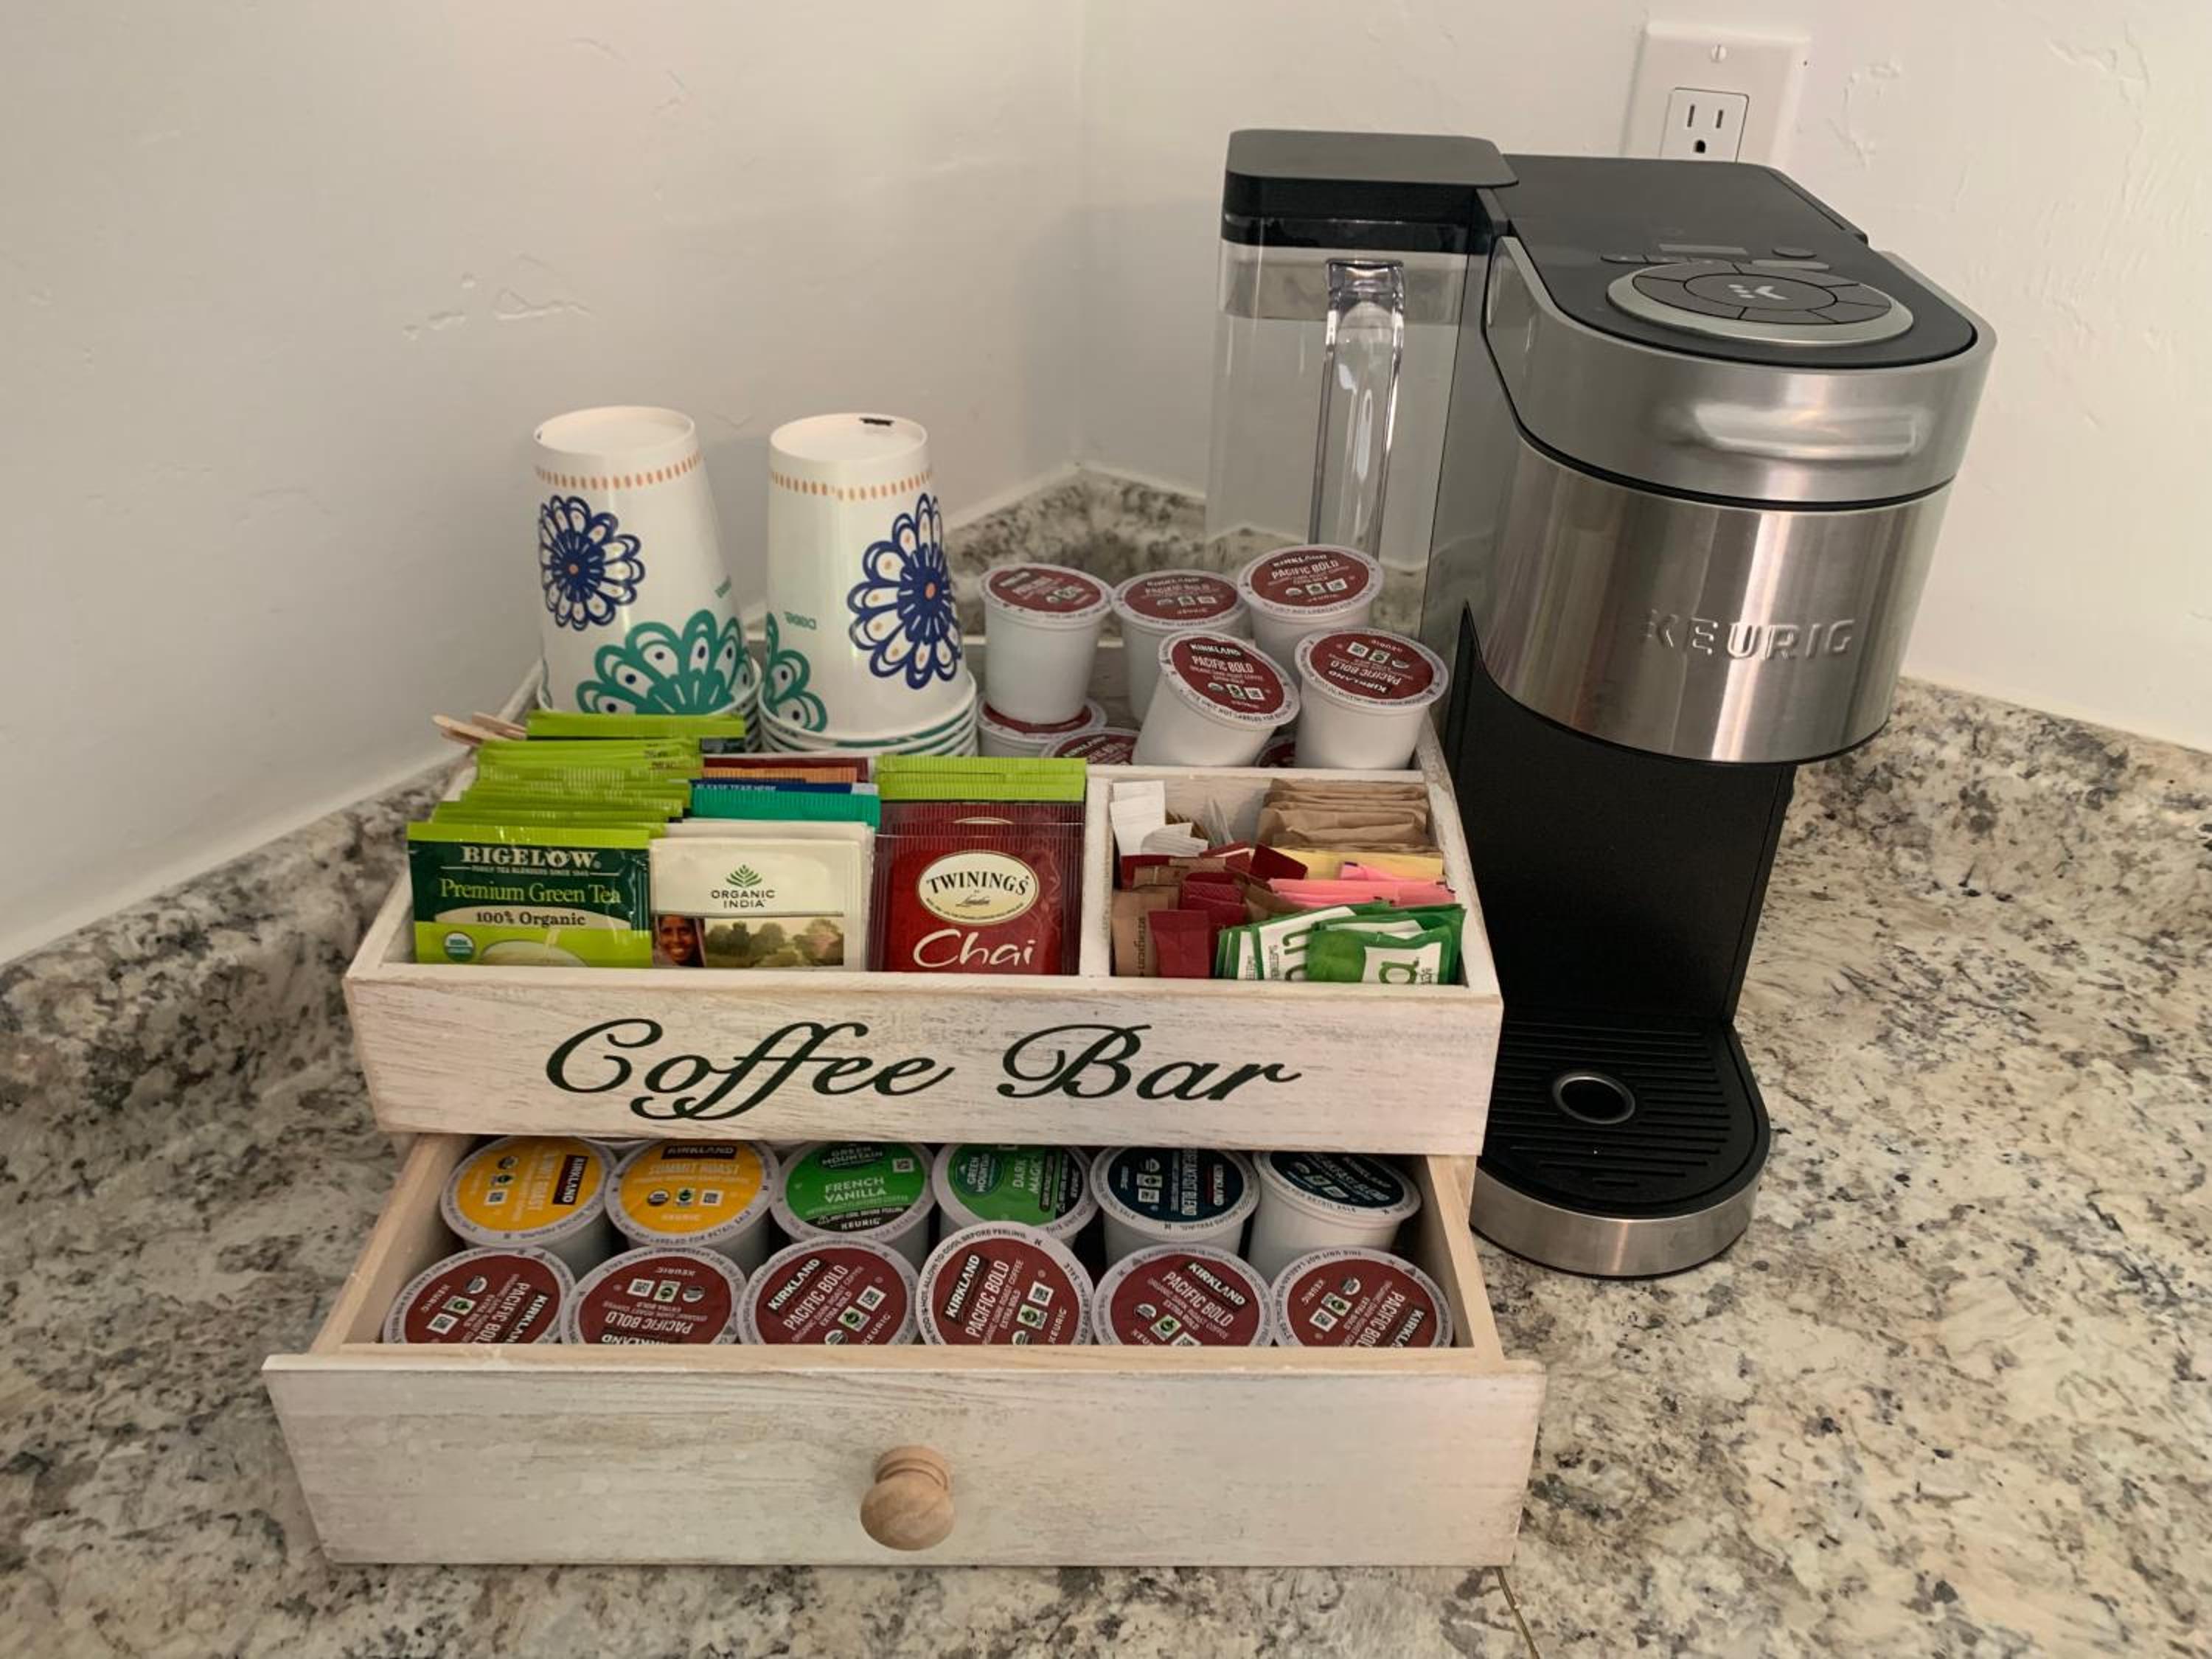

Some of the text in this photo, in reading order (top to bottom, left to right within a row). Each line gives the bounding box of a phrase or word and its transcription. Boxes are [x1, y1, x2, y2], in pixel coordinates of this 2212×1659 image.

[1272, 560, 1339, 579] PACIFIC BOLD
[1644, 609, 1855, 661] KEURIG
[1192, 655, 1254, 673] PACIFIC BOLD
[1331, 660, 1402, 686] PACIFIC BOLD
[460, 846, 599, 869] BIGELOW
[439, 878, 622, 904] Premium Green Tea
[711, 890, 775, 899] ORGANIC
[926, 871, 1029, 897] TWININGS
[723, 900, 765, 908] INDIA
[476, 911, 585, 928] 100% Organic
[913, 928, 1036, 968] Chai
[544, 1018, 1304, 1121] Coffee Bar
[667, 1147, 734, 1155] KIRKLAND
[562, 1158, 585, 1203] KIRKLAND
[825, 1177, 885, 1193] FRENCH
[1012, 1159, 1026, 1190] DARK
[1029, 1155, 1043, 1194] MAGIC
[825, 1187, 887, 1204] VANILLA
[1181, 1191, 1197, 1216] BLEND
[841, 1217, 882, 1231] KEURIG
[768, 1258, 821, 1310] KIRKLAND
[1005, 1258, 1026, 1285] COFFEE
[1188, 1262, 1246, 1306] KIRKLAND
[783, 1290, 825, 1331] PACIFIC
[817, 1265, 849, 1295] BOLD
[945, 1254, 981, 1318] KIRKLAND
[965, 1259, 1010, 1338] PACIFIC BOLD
[1161, 1270, 1234, 1327] PACIFIC BOLD
[1301, 1279, 1325, 1305] KEURIG
[492, 1281, 531, 1322] PACIFIC
[506, 1294, 549, 1343] KIRKLAN
[605, 1311, 694, 1335] PACIFIC BOLD
[818, 1307, 840, 1327] EXTRA
[861, 1313, 891, 1345] KEURIG
[998, 1307, 1016, 1330] EXTRA
[1048, 1305, 1067, 1344] KEURIG
[1356, 1291, 1406, 1347] PACIFIC BOL
[1392, 1308, 1425, 1347] KIRKLA
[472, 1324, 501, 1343] BOL
[602, 1334, 669, 1345] KLAND
[1131, 1329, 1154, 1346] KEU
